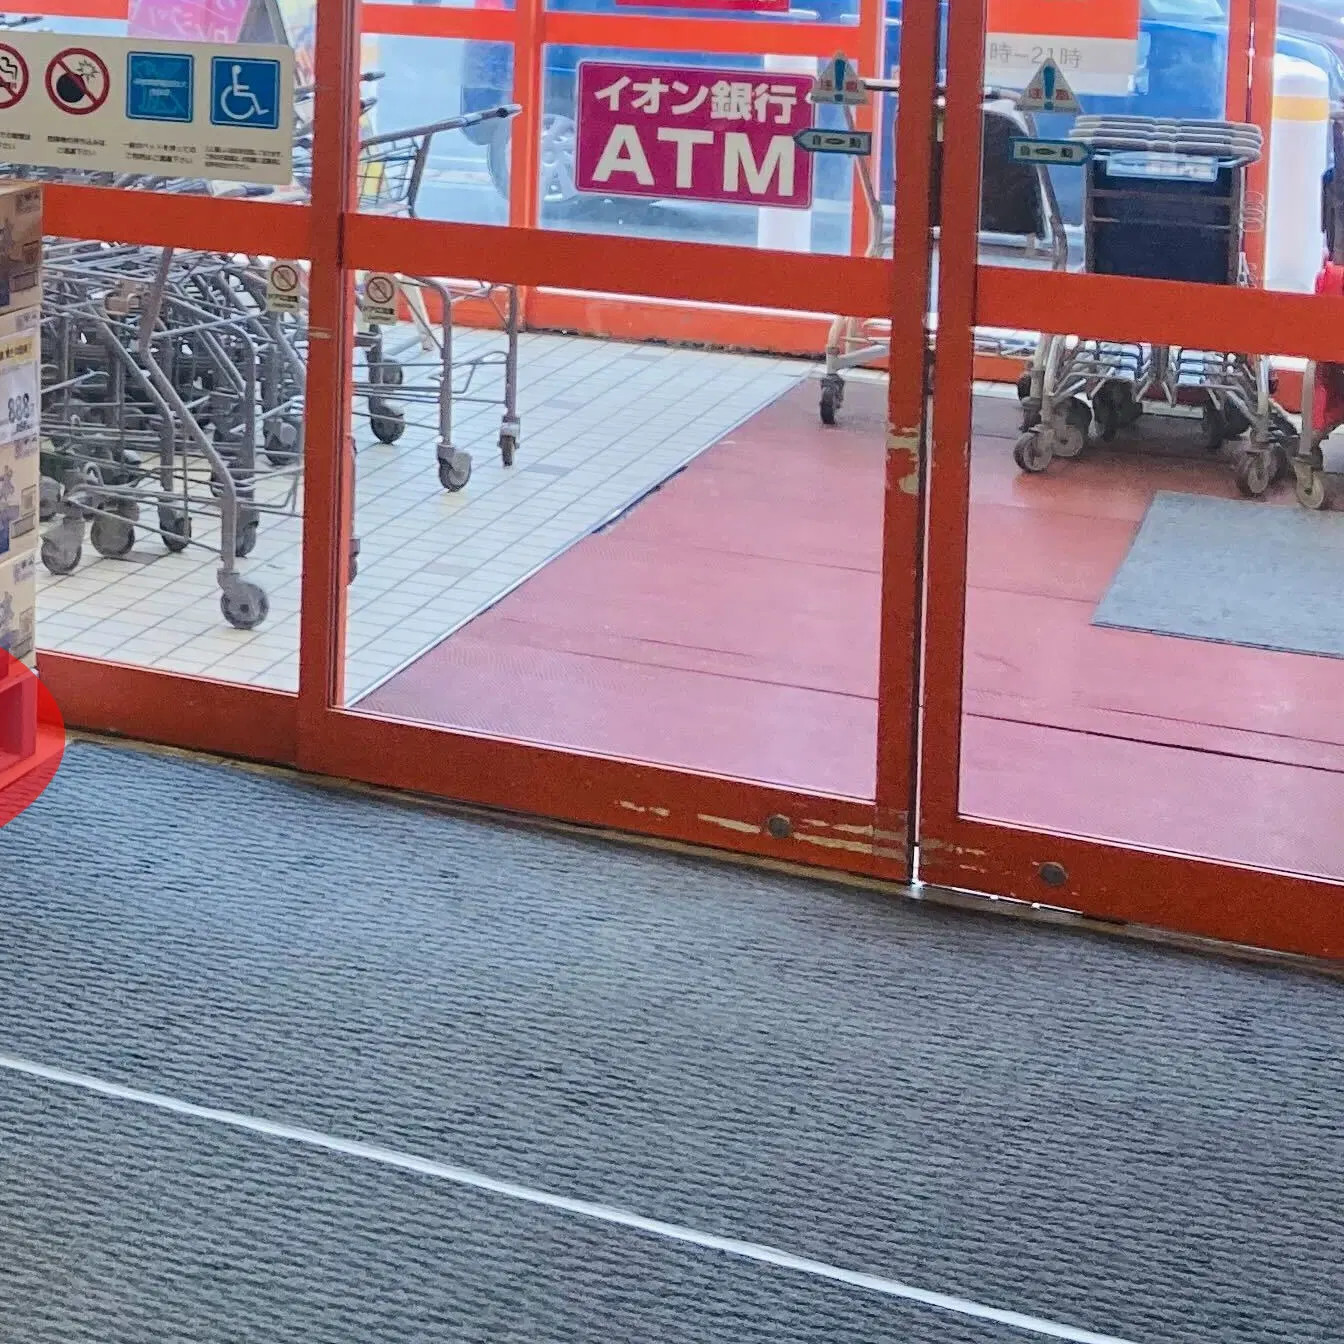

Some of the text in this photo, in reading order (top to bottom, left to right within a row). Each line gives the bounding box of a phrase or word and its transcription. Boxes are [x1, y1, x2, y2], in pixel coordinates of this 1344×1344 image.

[594, 75, 797, 124] イオン銀行
[592, 123, 796, 197] ATM
